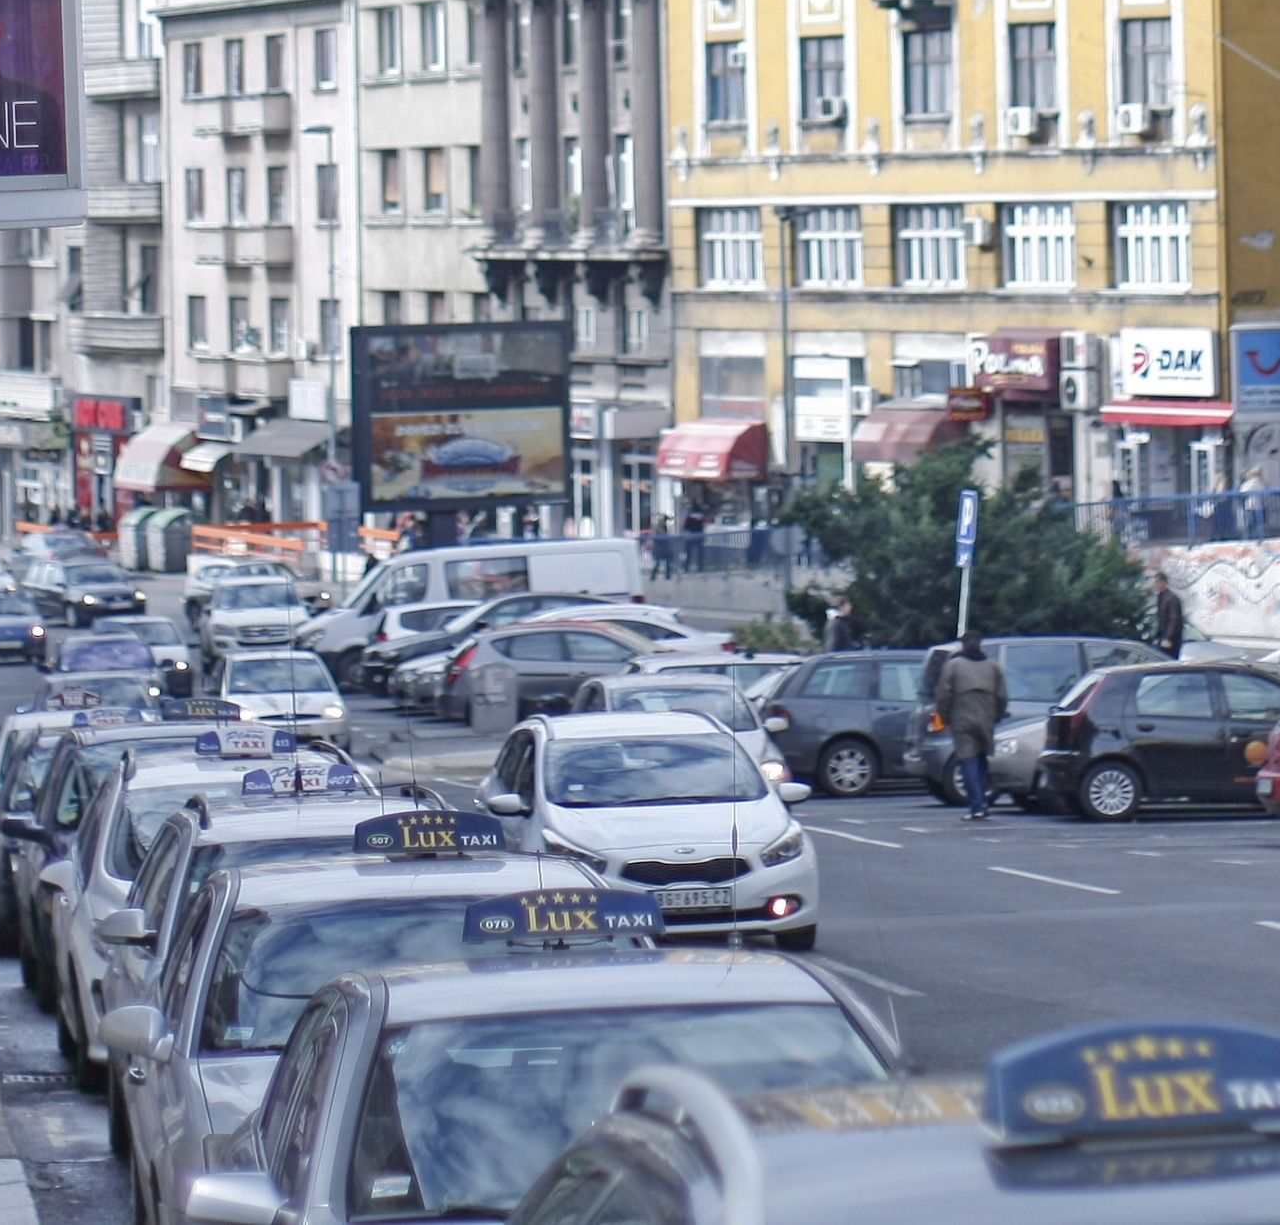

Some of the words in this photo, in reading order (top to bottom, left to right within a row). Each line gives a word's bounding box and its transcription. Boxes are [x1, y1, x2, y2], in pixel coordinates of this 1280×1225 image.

[960, 497, 974, 536] P
[233, 741, 266, 749] TAXI
[371, 836, 389, 845] 507
[401, 825, 456, 848] Lux
[460, 834, 497, 846] TAXI
[485, 919, 509, 930] 076
[526, 905, 599, 932] Lux
[604, 913, 653, 929] TAXI
[1091, 1066, 1219, 1120] Lux
